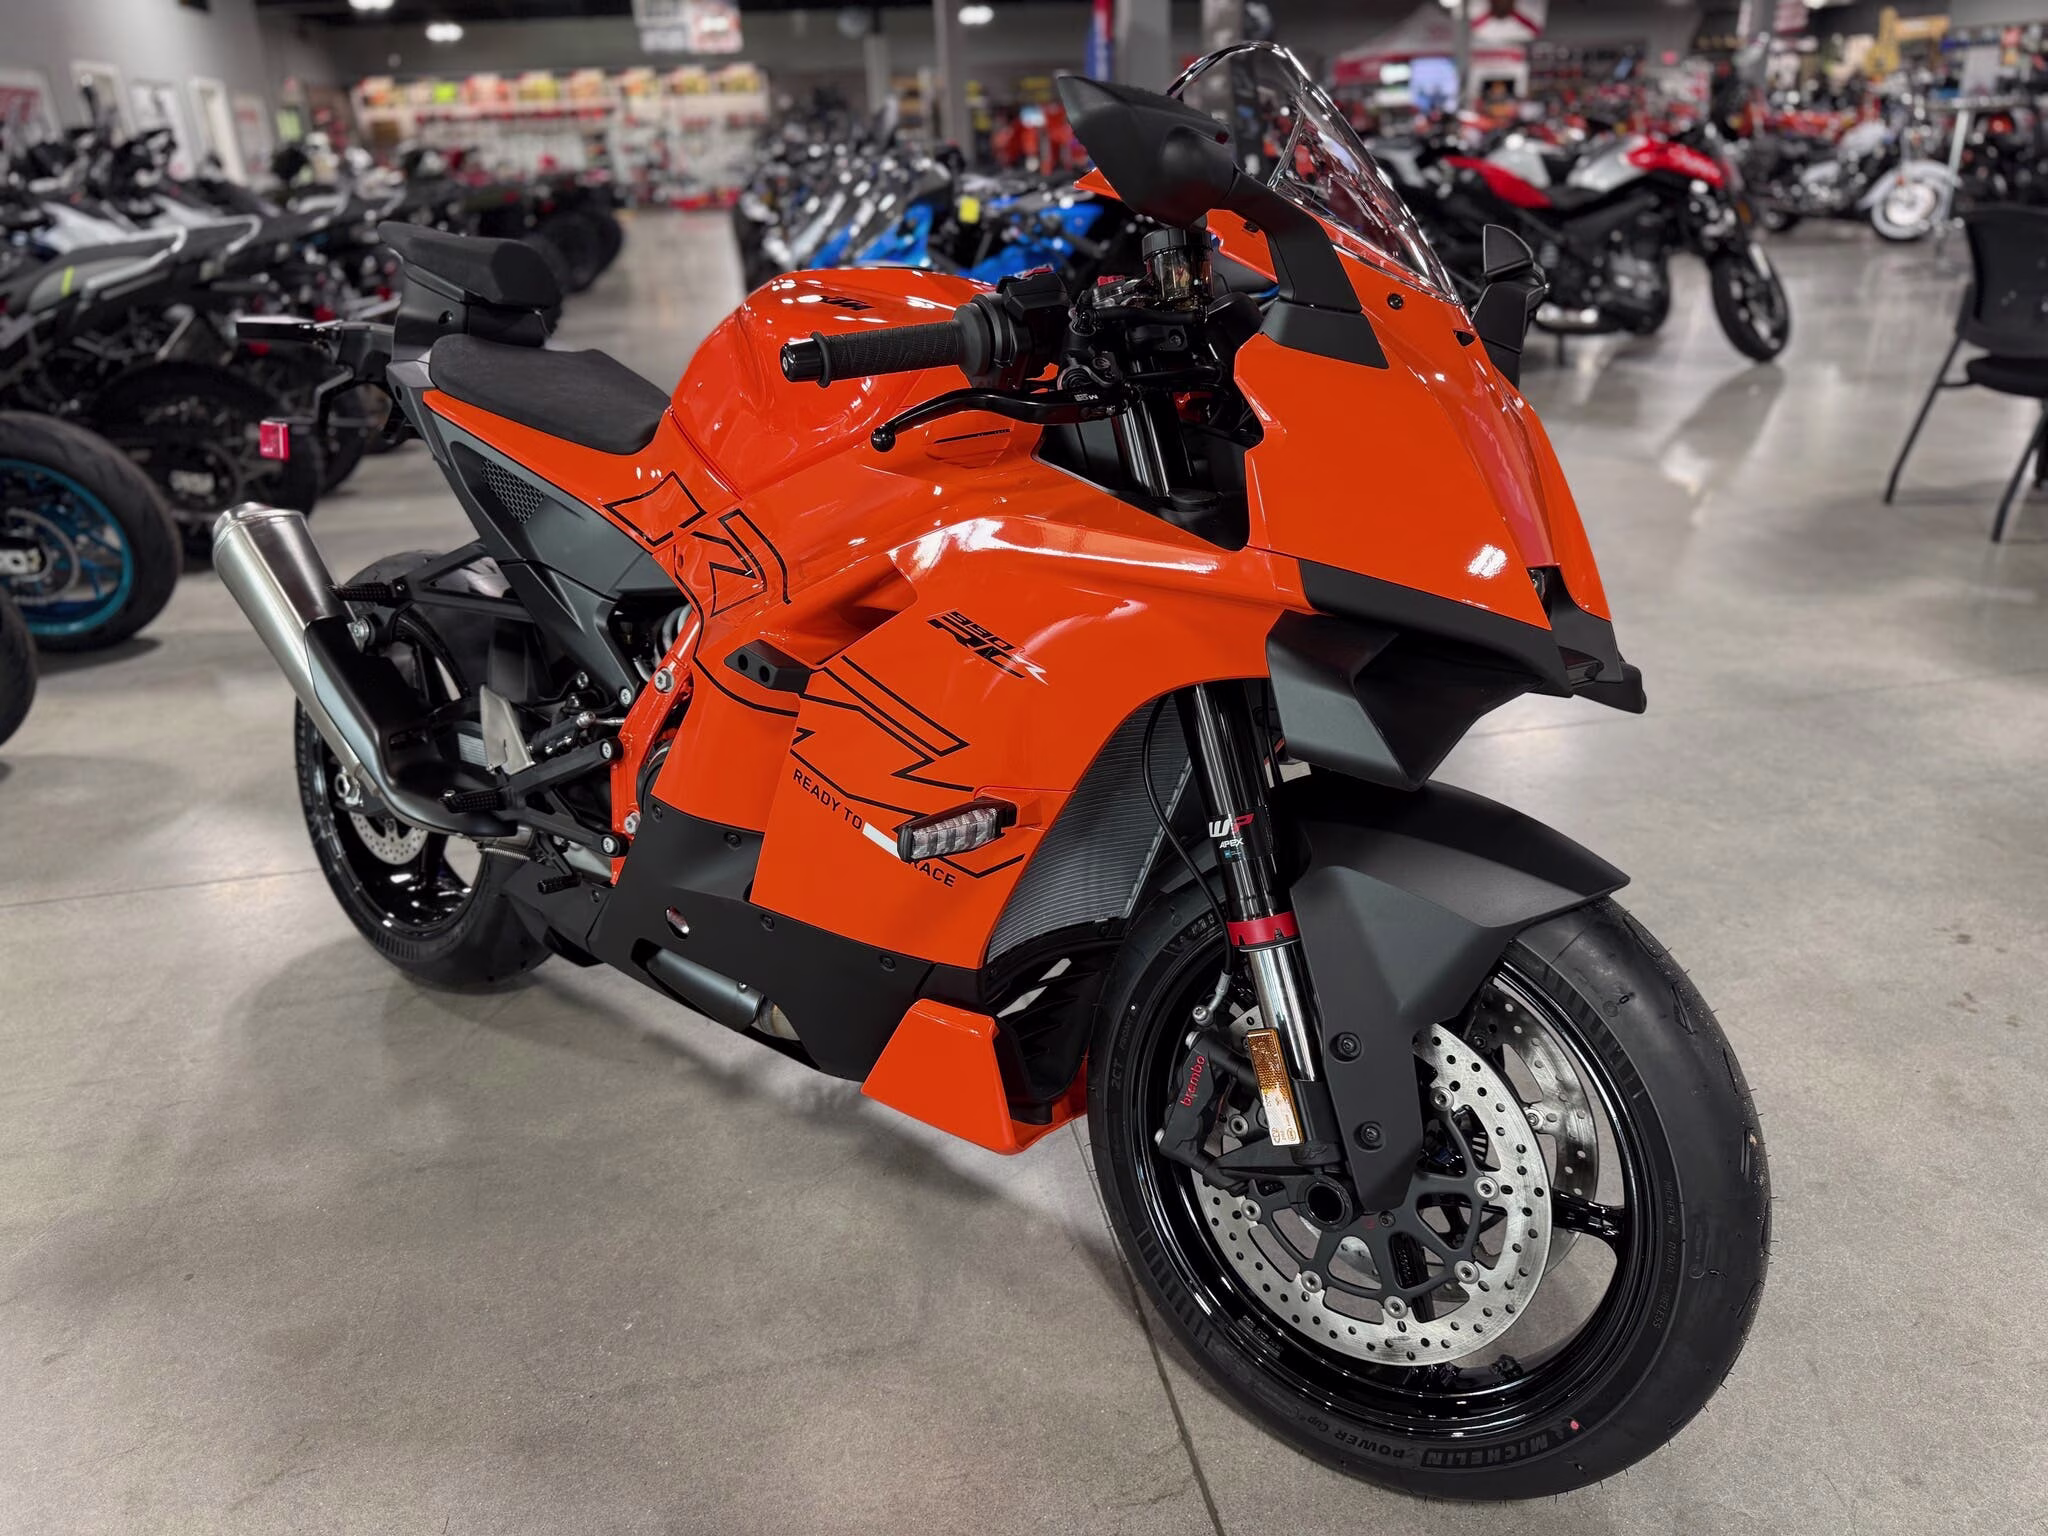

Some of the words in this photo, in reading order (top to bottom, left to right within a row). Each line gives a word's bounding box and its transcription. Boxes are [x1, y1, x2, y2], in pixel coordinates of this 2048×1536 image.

[945, 611, 1016, 651] 990
[793, 768, 841, 811] READY
[844, 807, 863, 830] TO
[1208, 813, 1254, 837] WP
[1219, 838, 1244, 849] APEX
[1180, 1055, 1206, 1107] brembo
[1333, 1429, 1406, 1458] POWER
[1425, 1434, 1549, 1465] MICHELIN
